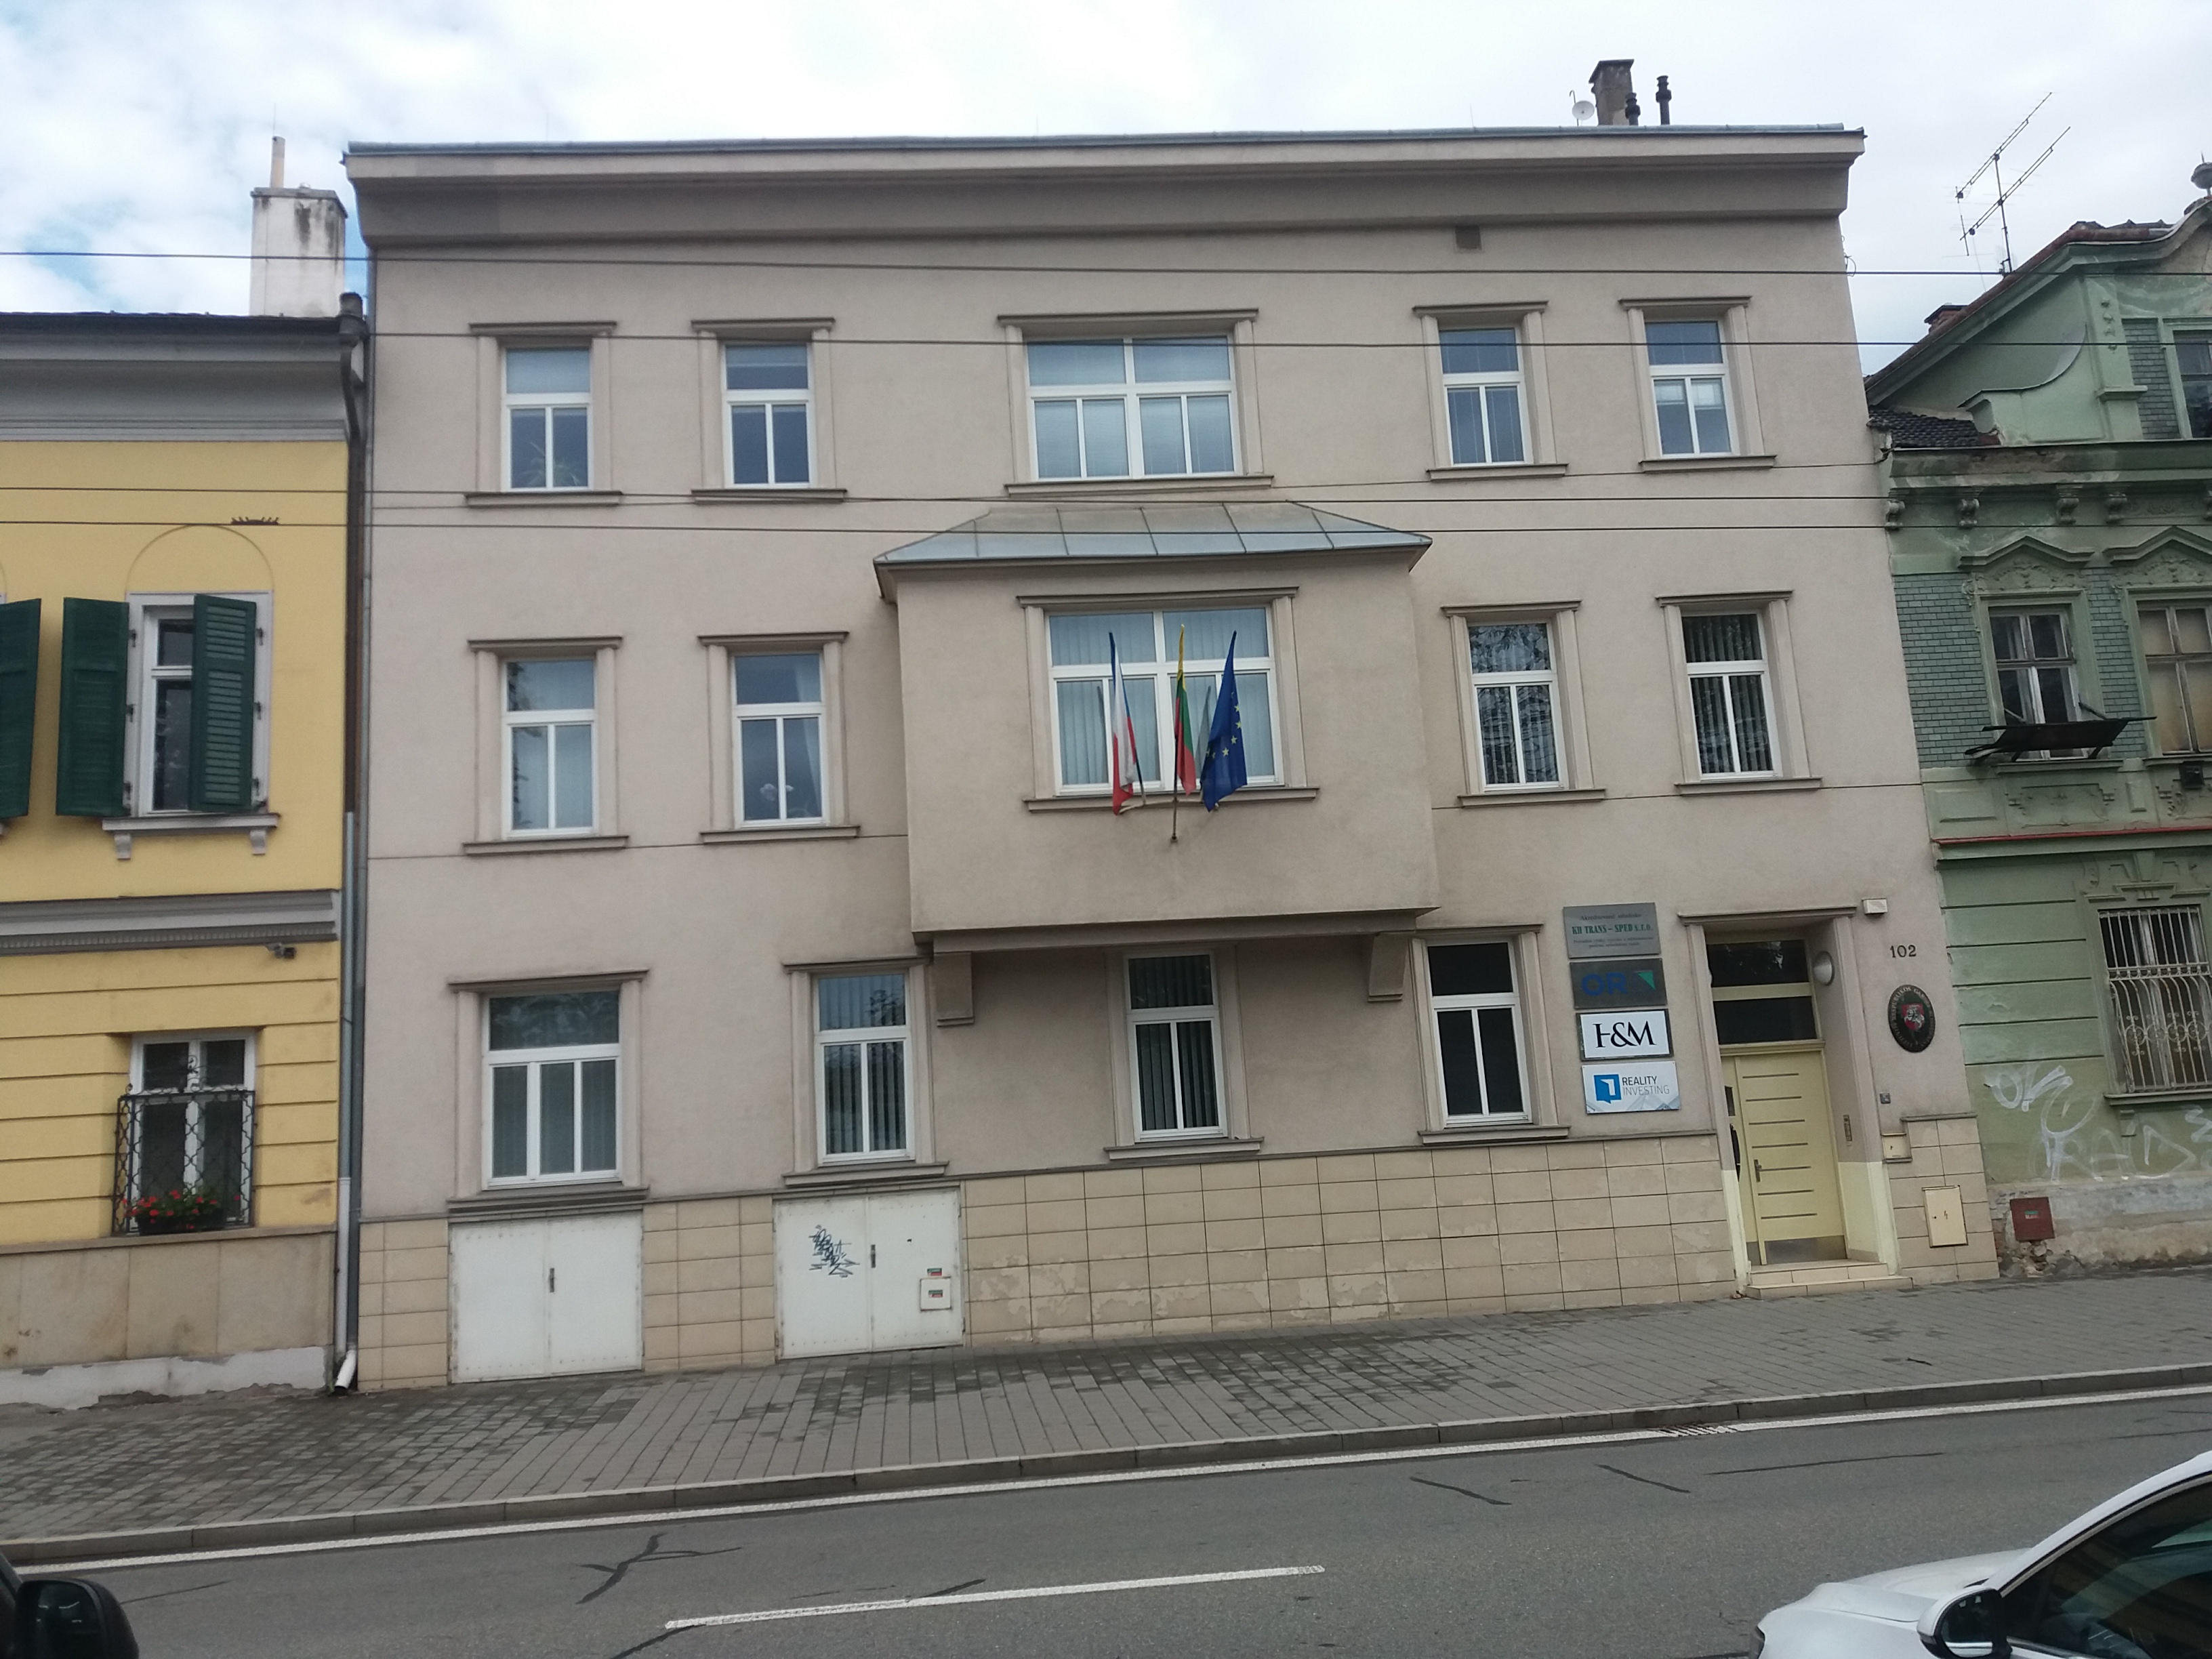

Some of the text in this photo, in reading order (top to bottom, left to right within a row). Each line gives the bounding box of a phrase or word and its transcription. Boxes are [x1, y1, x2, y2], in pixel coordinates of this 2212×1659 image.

[1584, 924, 1607, 934] TRANS
[1615, 924, 1633, 933] SPED
[1634, 924, 1653, 932] s.r.o.
[1889, 945, 1917, 958] 102
[1593, 1021, 1657, 1048] H&M
[1622, 1076, 1657, 1086] REALITY
[1623, 1085, 1670, 1096] INVESTING
